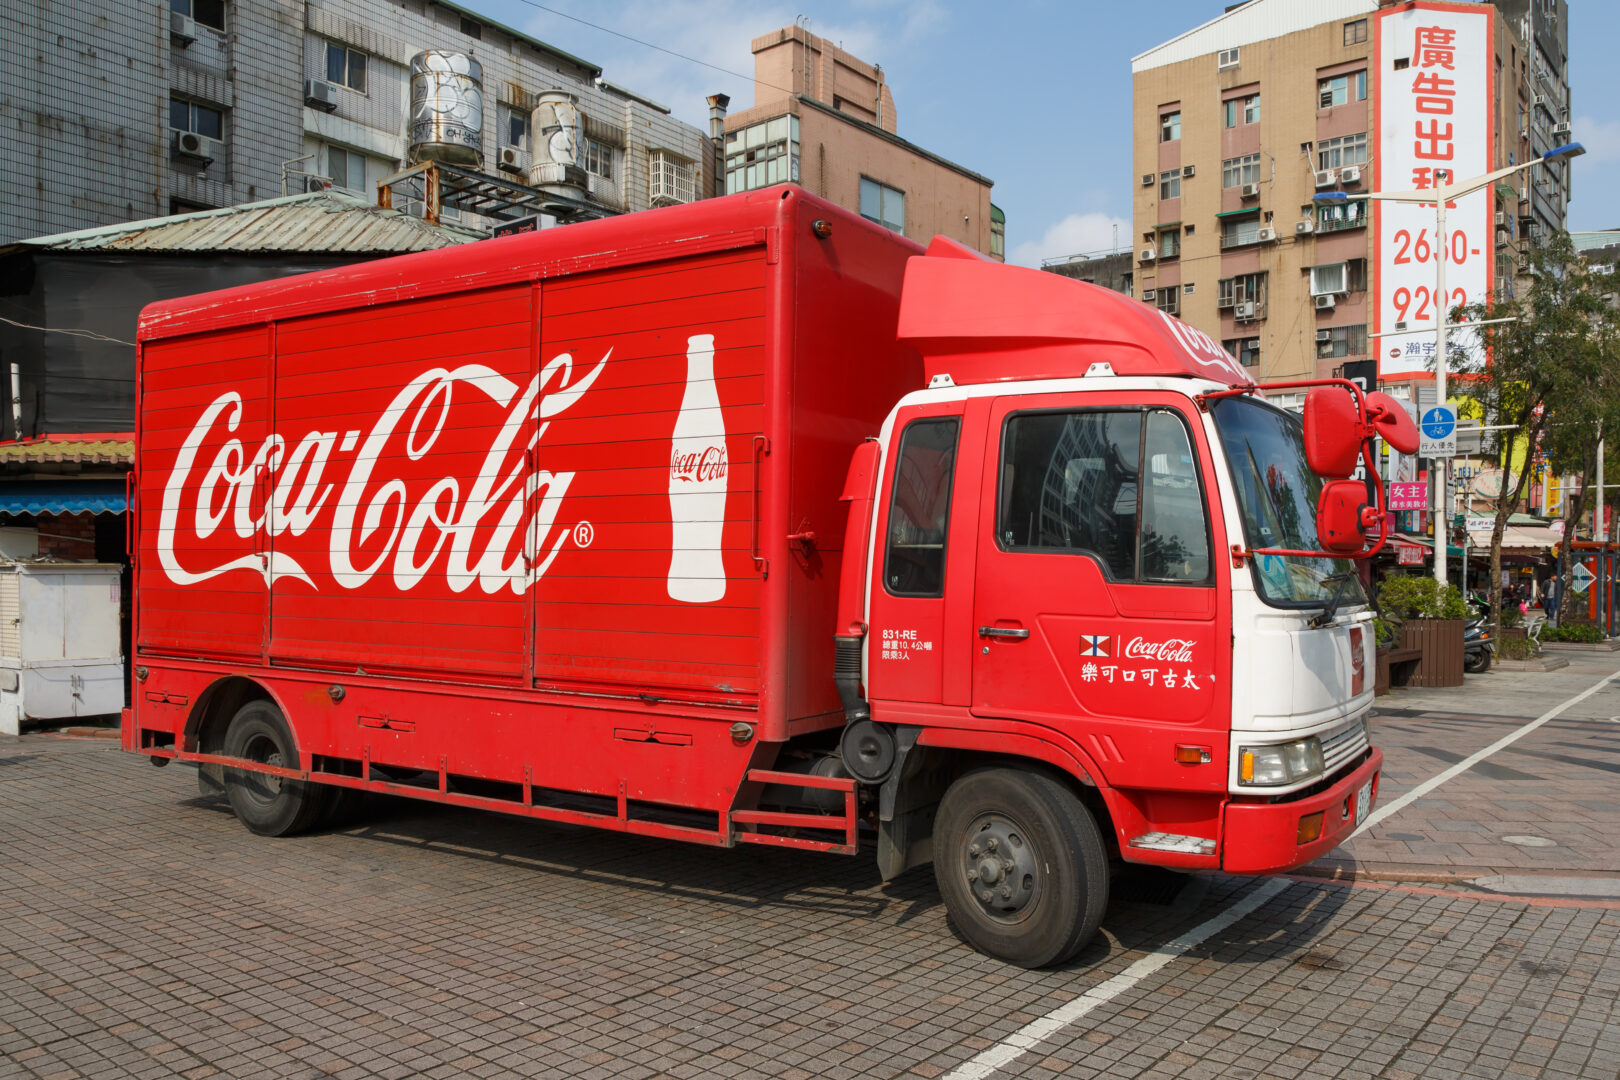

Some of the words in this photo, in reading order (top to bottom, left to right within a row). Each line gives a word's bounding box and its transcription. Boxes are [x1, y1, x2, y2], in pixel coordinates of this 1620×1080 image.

[1406, 342, 1467, 355] 瀚宇
[1421, 441, 1454, 450] 行人優先
[157, 346, 614, 595] Coca-Cola
[882, 629, 917, 640] 831-RE
[1125, 636, 1198, 662] Coca-Cola
